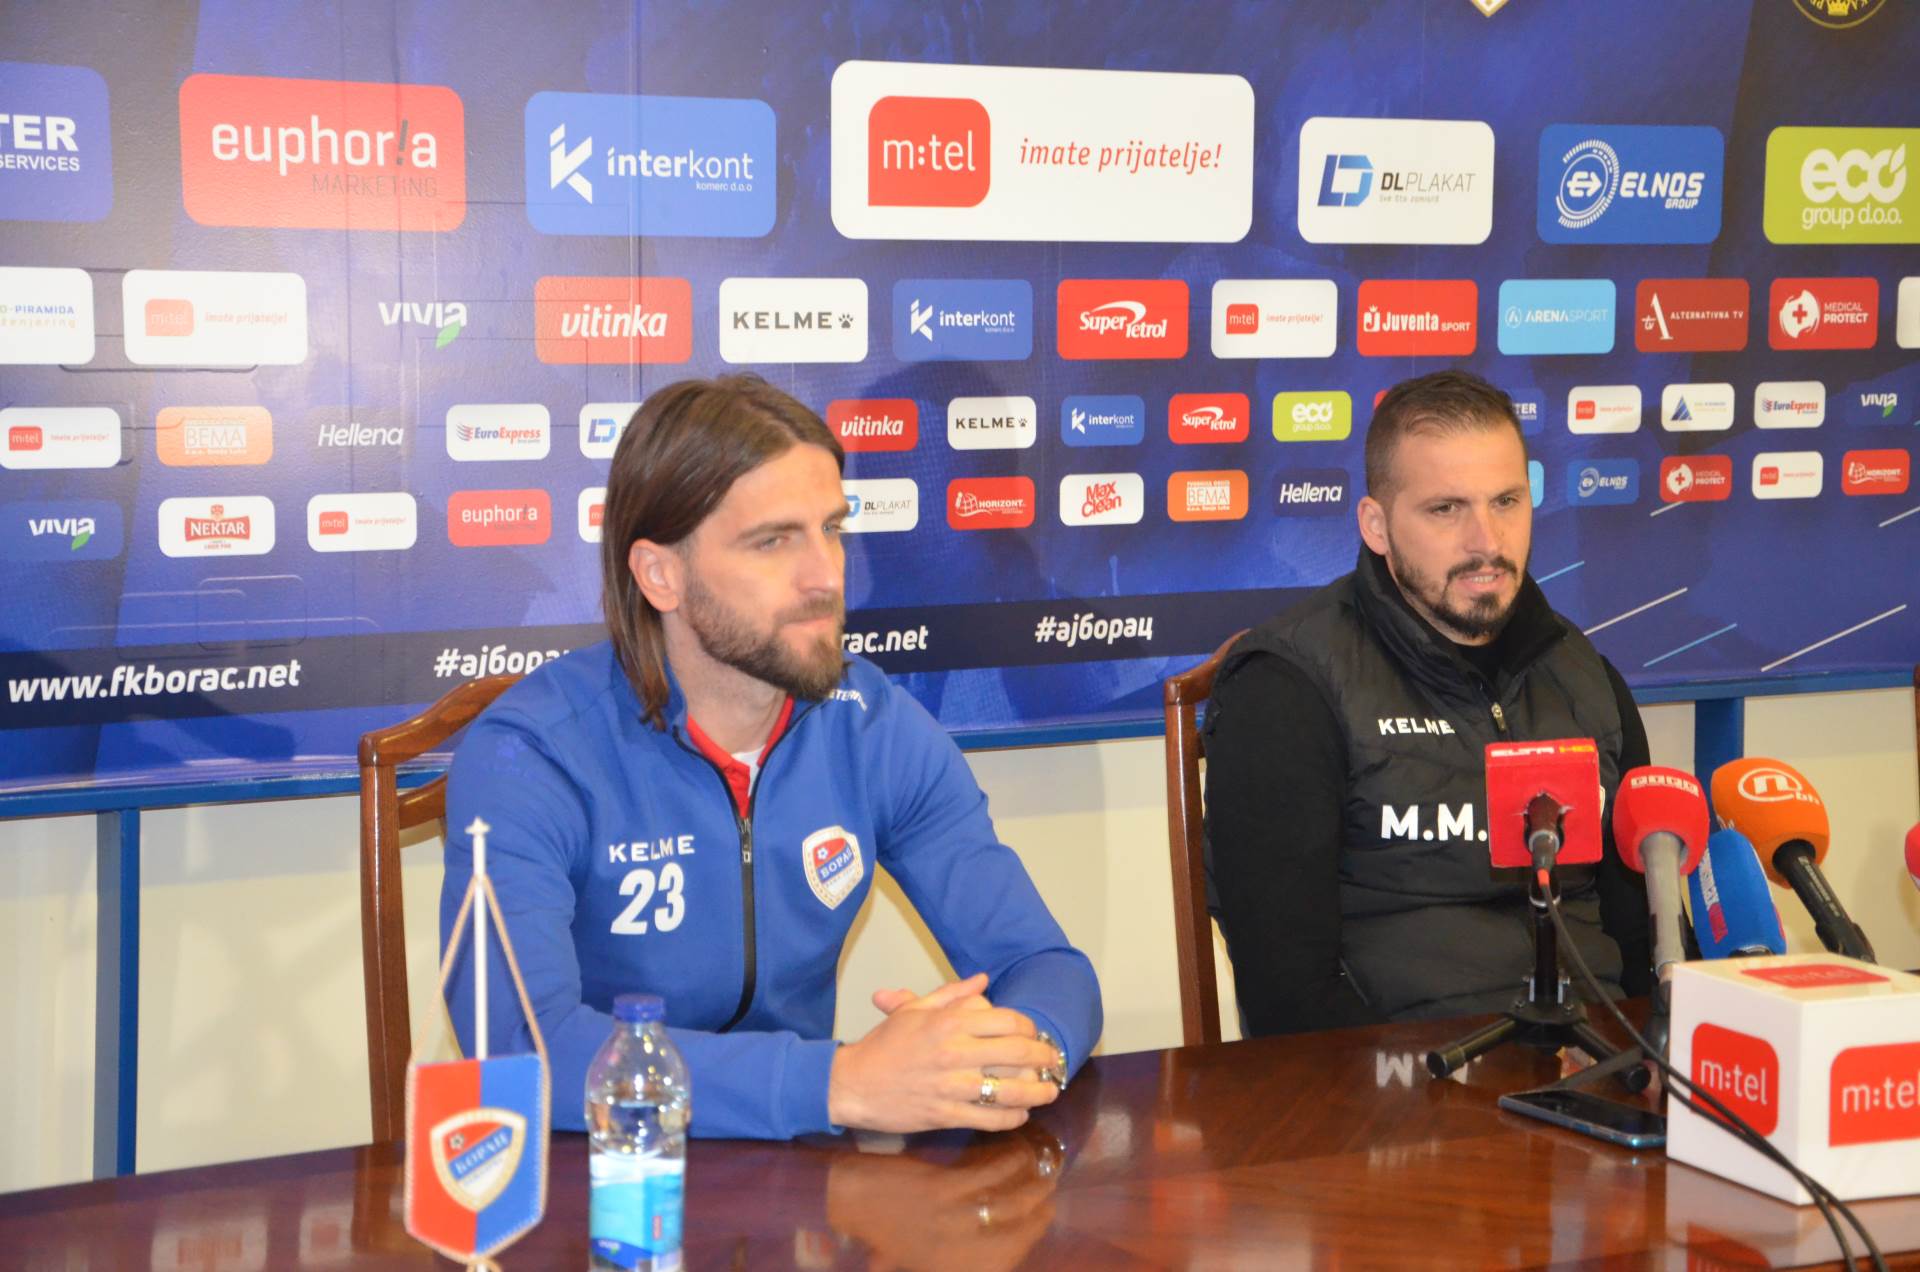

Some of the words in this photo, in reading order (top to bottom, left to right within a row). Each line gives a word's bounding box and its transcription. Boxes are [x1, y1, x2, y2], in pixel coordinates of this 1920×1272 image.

[883, 130, 976, 171] m:tel
[1020, 138, 1090, 166] imate
[1099, 141, 1222, 174] prijatelje!
[607, 146, 753, 180] interkont
[1800, 144, 1907, 204] eco
[1619, 171, 1705, 198] ELNOS
[1664, 198, 1699, 210] GROUP
[1801, 206, 1854, 231] group
[939, 308, 1015, 328] interkont
[1670, 310, 1729, 320] ALTERNATIVNA
[1733, 310, 1744, 320] TV
[1823, 312, 1869, 325] PROTECT
[1824, 302, 1863, 313] MEDICAL
[560, 304, 667, 339] vitinka
[733, 311, 833, 330] KELME
[1079, 311, 1127, 332] Super
[1382, 310, 1439, 332] Juventa
[1441, 322, 1471, 332] SPORT
[955, 416, 1016, 430] KELME
[1088, 412, 1135, 426] interkont
[1182, 414, 1212, 430] Super
[1292, 401, 1334, 423] eco
[318, 423, 404, 448] Hellena
[474, 426, 541, 445] EuroExpress
[840, 414, 905, 437] vitinka
[185, 426, 246, 448] BEMA
[1085, 481, 1117, 499] Max
[1188, 488, 1230, 504] BEMA
[1279, 482, 1343, 504] Hellena
[1081, 495, 1122, 518] Clean
[190, 520, 247, 537] NEKTAR
[433, 645, 570, 679] #ајбор
[9, 659, 301, 702] www.fkborac.net
[1378, 717, 1456, 736] KELME
[1380, 802, 1488, 841] M.M.
[608, 835, 696, 863] KELME
[610, 862, 686, 935] 23
[1699, 1058, 1768, 1106] m:tel
